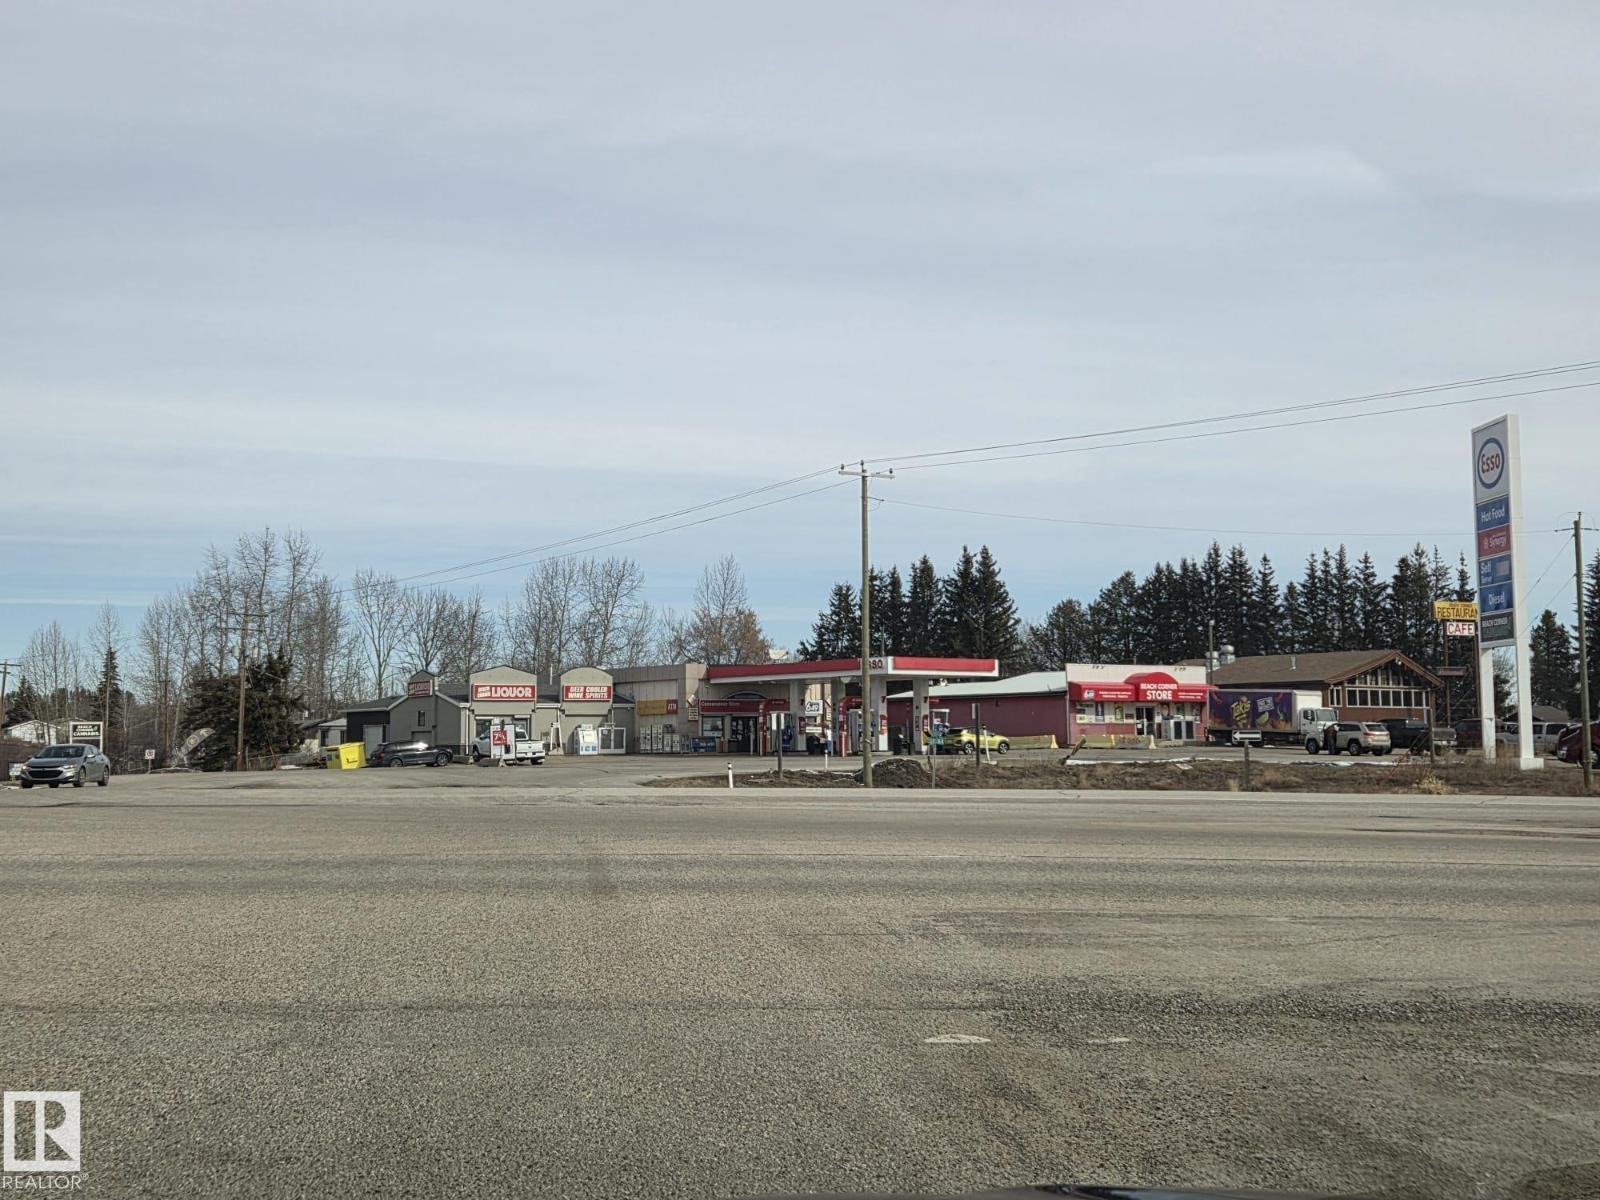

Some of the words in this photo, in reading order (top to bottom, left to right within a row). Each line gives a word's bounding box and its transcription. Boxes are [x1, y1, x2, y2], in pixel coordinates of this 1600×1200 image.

[1481, 453, 1501, 474] Esso
[1491, 505, 1505, 518] Food
[1447, 623, 1474, 635] CAFE
[491, 686, 532, 698] LIQUOR
[1146, 690, 1172, 700] STORE
